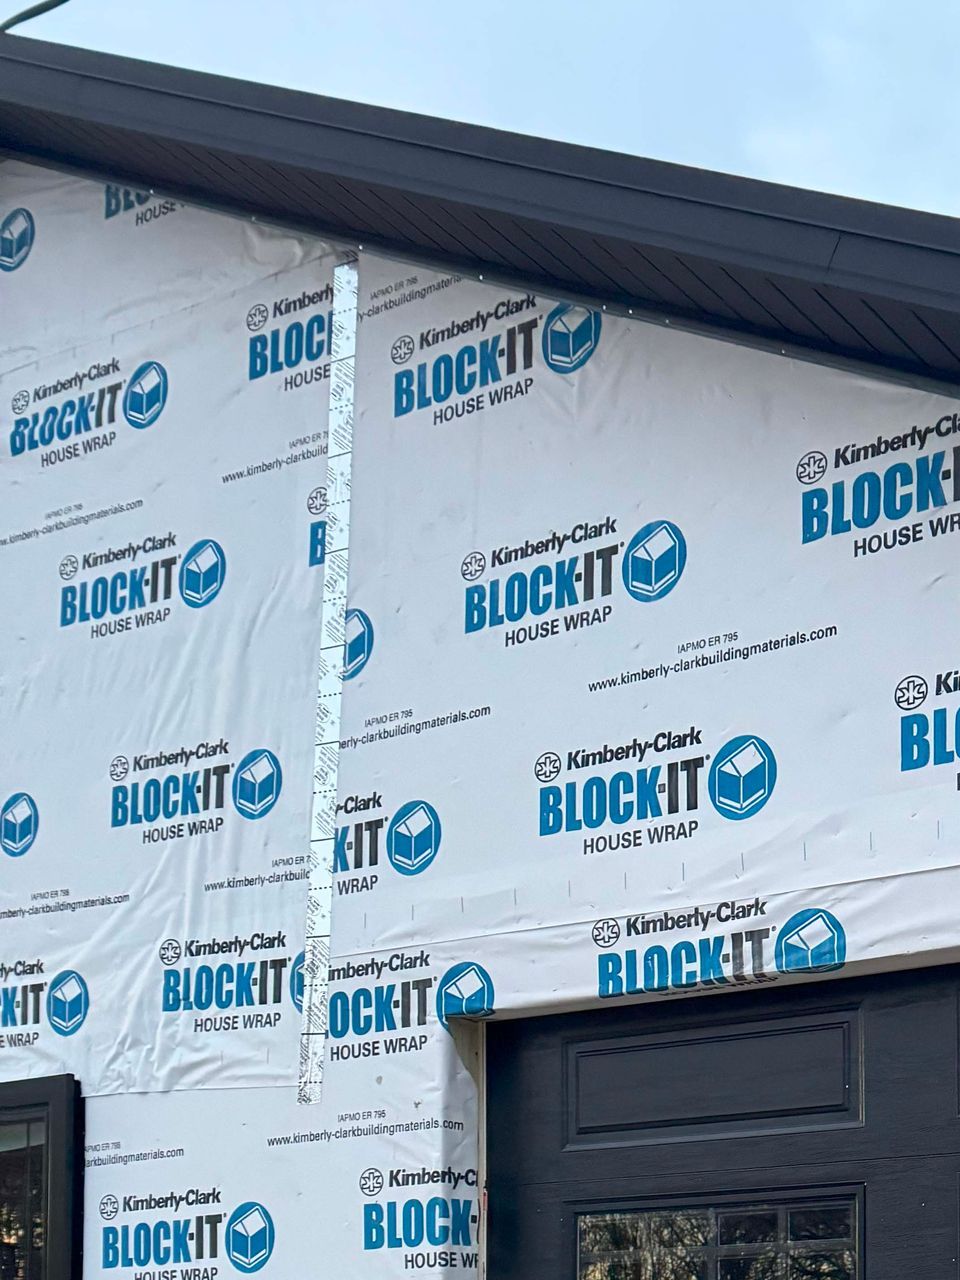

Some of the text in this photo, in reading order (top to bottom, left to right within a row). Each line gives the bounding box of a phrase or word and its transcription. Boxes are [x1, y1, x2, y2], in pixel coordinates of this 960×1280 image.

[419, 294, 537, 351] Kimberly-Clark
[33, 357, 120, 403] Kimberly-Clark
[285, 363, 331, 391] HOUSE
[433, 378, 534, 426] HOUSE WRAP
[41, 431, 116, 467] HOUSE WRAP
[82, 532, 177, 570] Kimberly-Clark
[491, 516, 617, 568] Kimberly-Clark
[854, 522, 923, 557] HOUSE
[90, 608, 171, 639] HOUSE WRAP
[504, 605, 613, 648] HOUSE WRAP
[588, 624, 838, 693] www.kimberly-clarkbuildingmaterials.com
[677, 631, 739, 654] IAPMO ER 795
[133, 738, 229, 771] Kimberly-Clark
[567, 726, 703, 771] Kimberly-Clark
[143, 817, 224, 844] HOUSE WRAP
[583, 820, 699, 855] HOUSE WRAP
[338, 875, 378, 896] WRAP
[626, 898, 768, 938] Kimberly-Clark
[184, 931, 286, 957] Kimberly-Clark
[7, 1032, 39, 1048] WRAP
[193, 1013, 281, 1033] HOUSE WRAP
[330, 1035, 428, 1061] HOUSE WRAP
[122, 1188, 221, 1213] Kimberly-Clark
[404, 1252, 457, 1270] HOUSE
